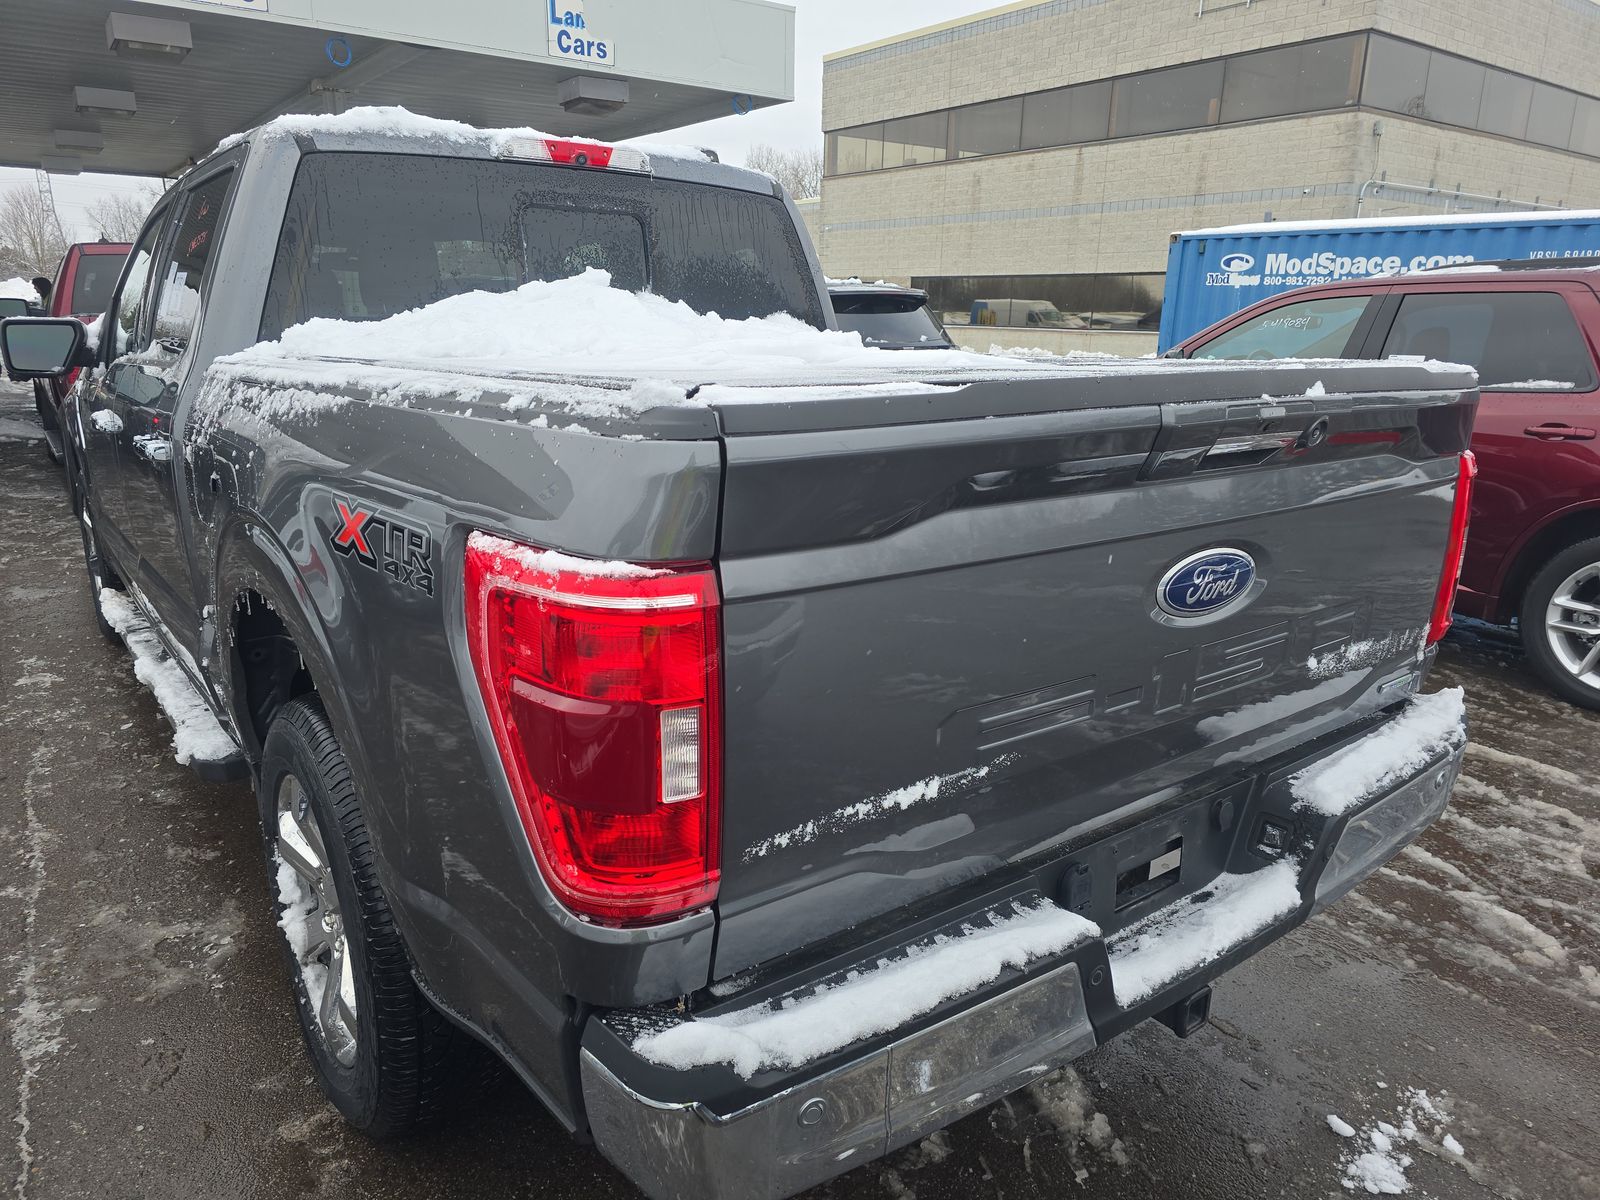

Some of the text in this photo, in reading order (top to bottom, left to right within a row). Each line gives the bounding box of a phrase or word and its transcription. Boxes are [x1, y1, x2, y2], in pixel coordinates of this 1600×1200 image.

[557, 29, 607, 59] Cars
[1264, 252, 1475, 278] ModSpace.com
[1263, 275, 1332, 286] 800-981-7292
[1185, 563, 1241, 605] Ford
